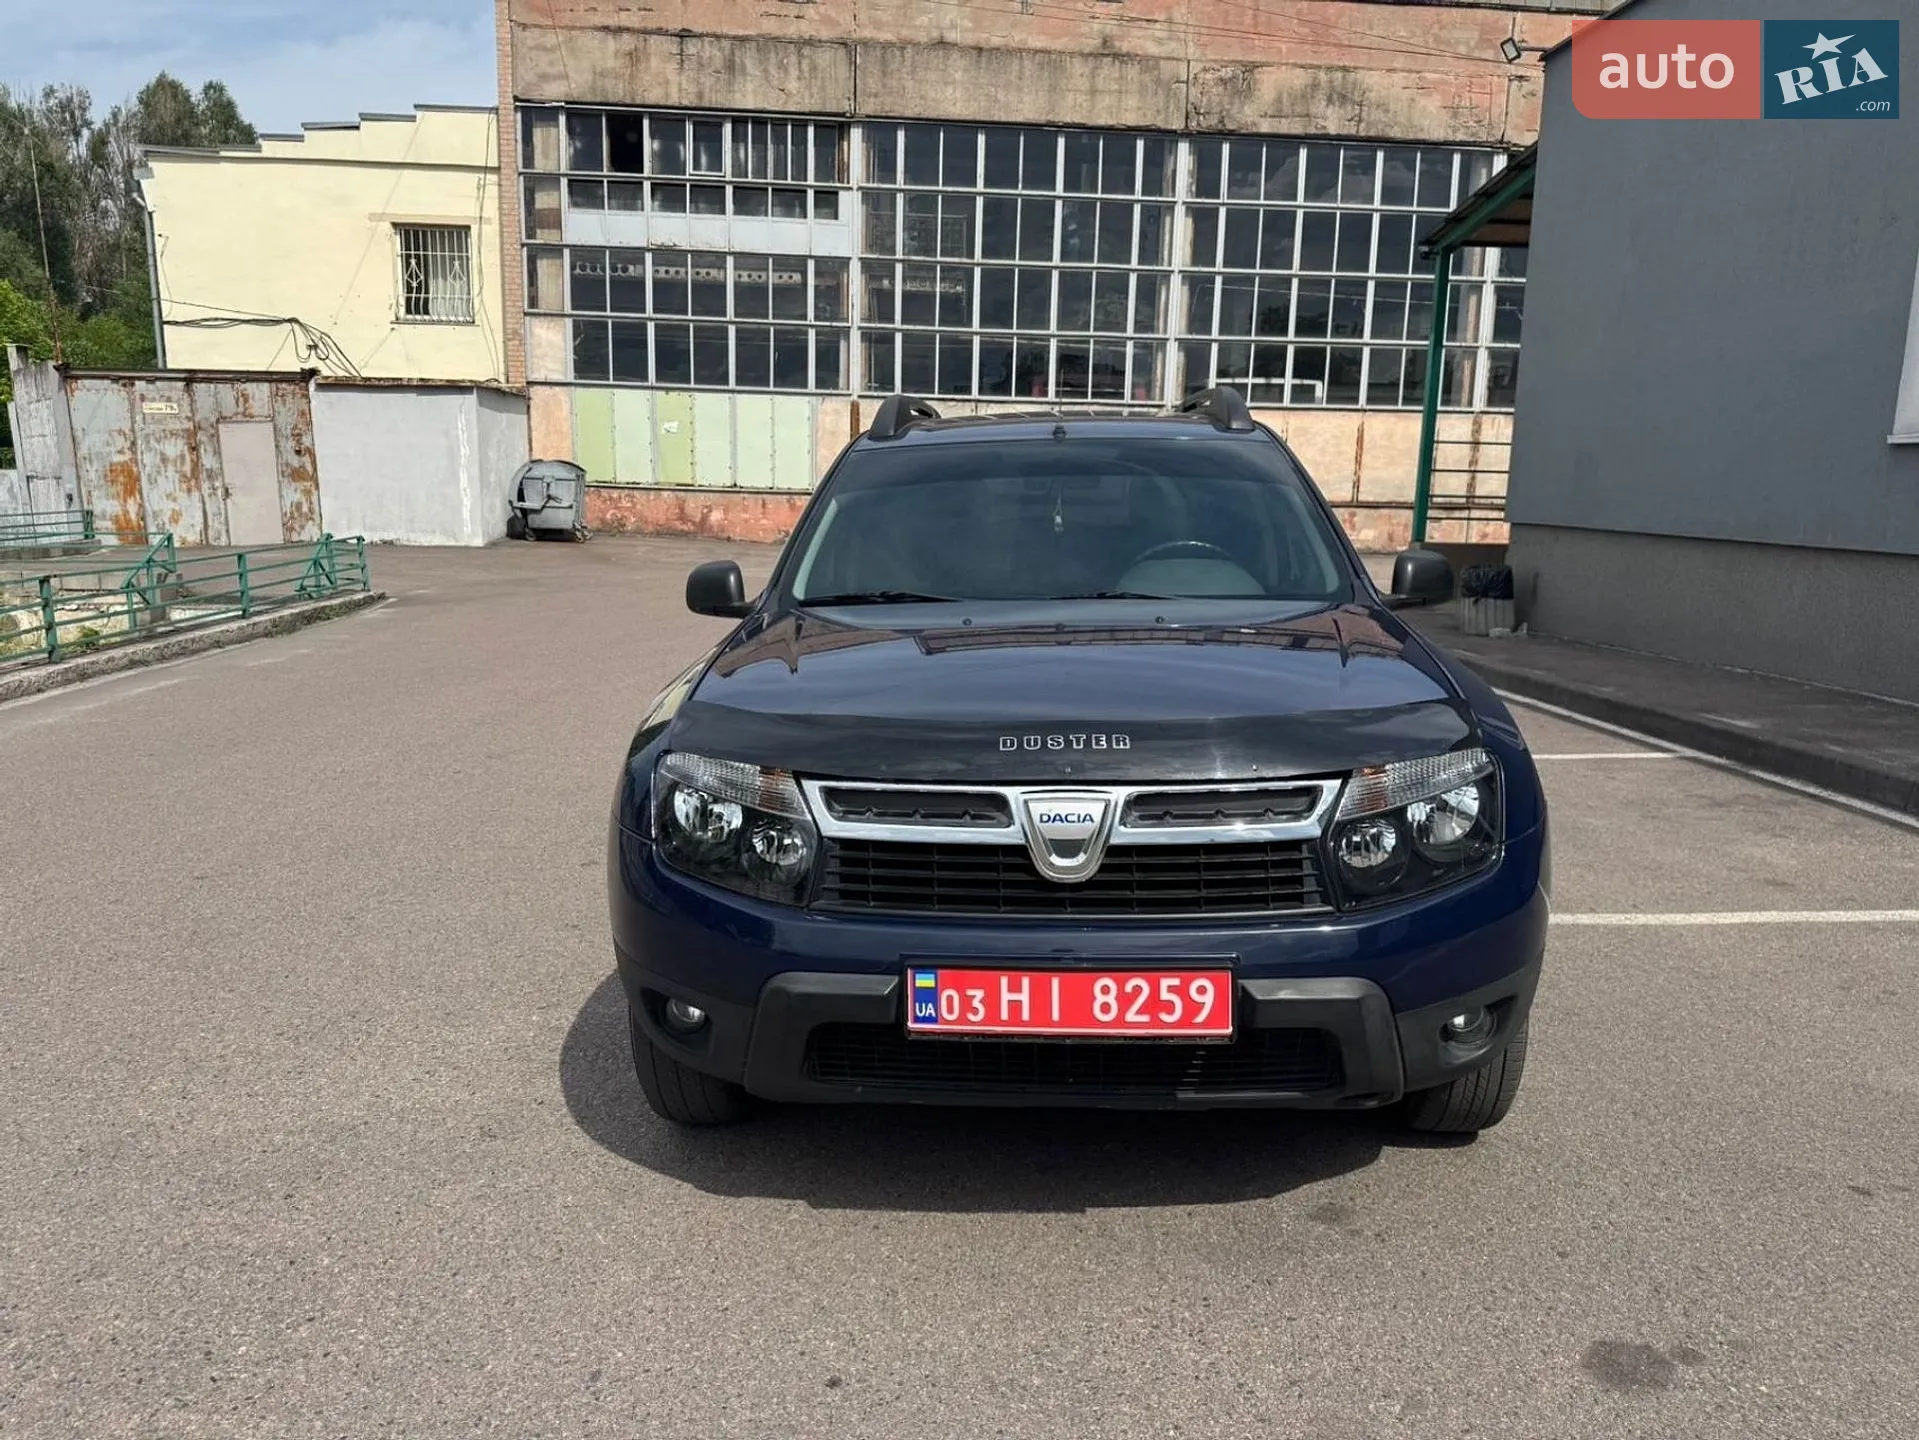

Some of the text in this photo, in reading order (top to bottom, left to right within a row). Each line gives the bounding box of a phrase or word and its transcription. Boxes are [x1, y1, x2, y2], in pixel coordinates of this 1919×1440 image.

[1000, 734, 1131, 751] DUSTER
[1039, 813, 1095, 824] DACIA
[941, 988, 985, 1022] 03
[1093, 977, 1215, 1023] 8259
[915, 1002, 937, 1018] UA
